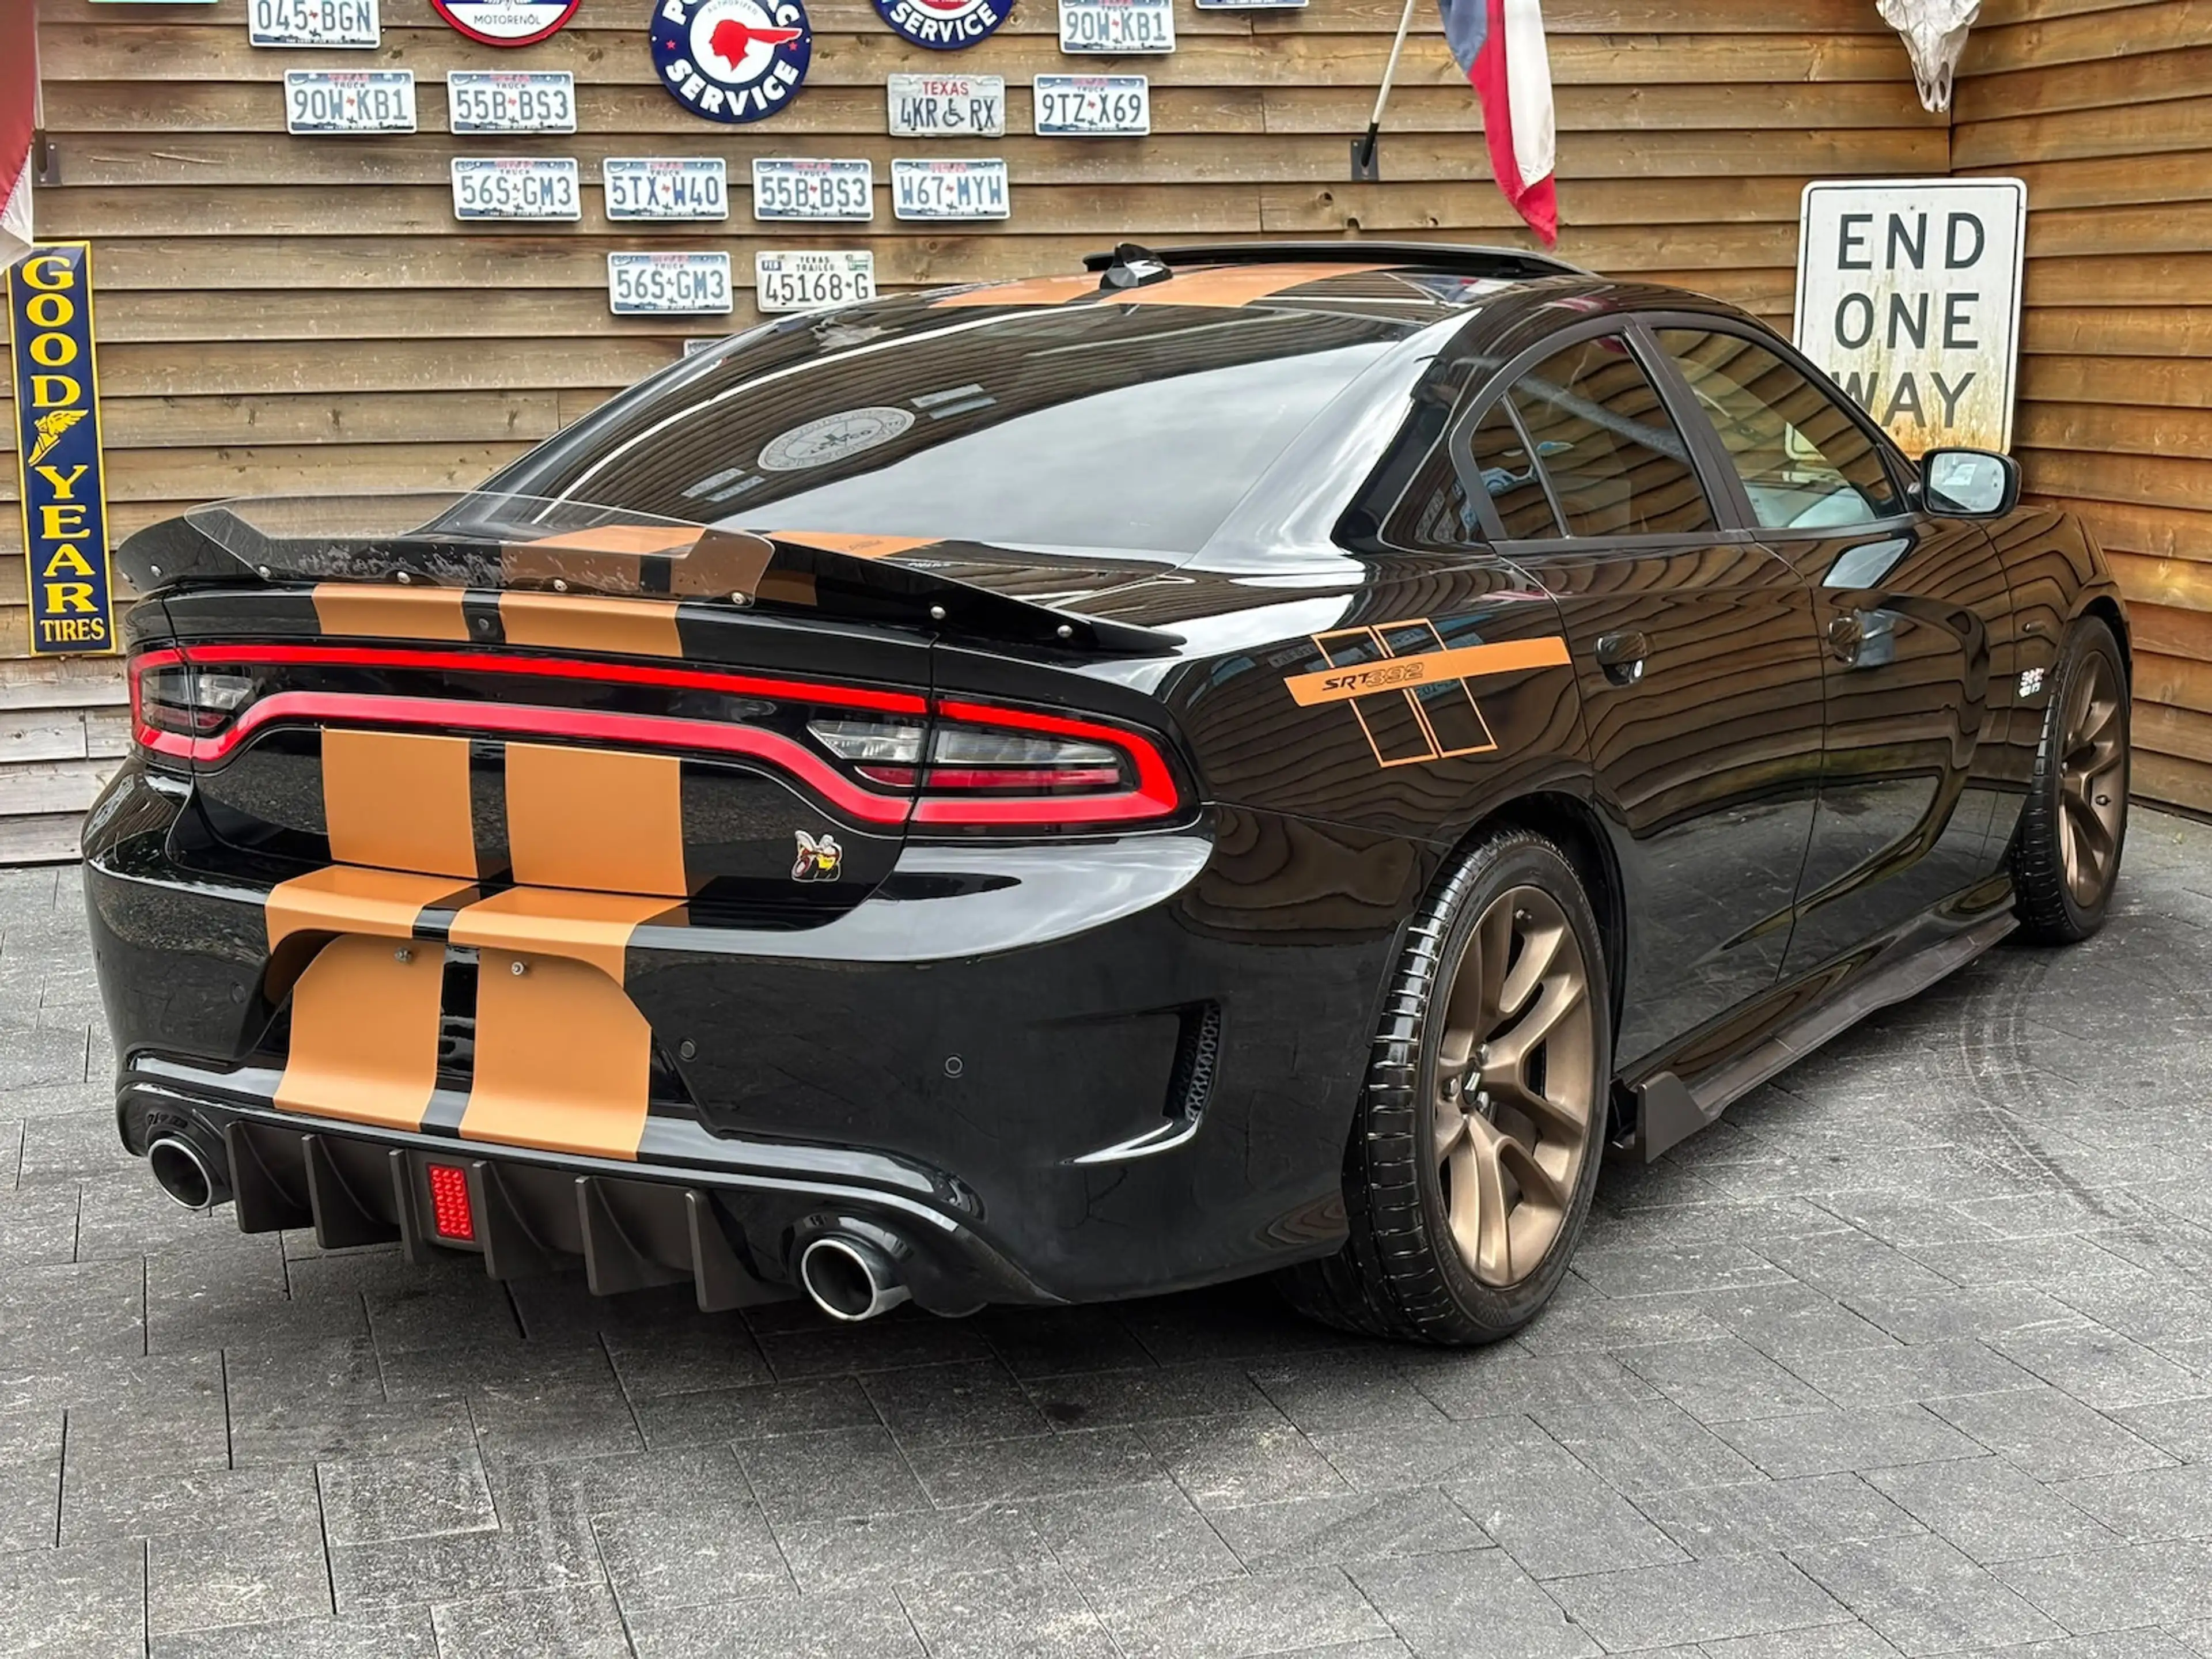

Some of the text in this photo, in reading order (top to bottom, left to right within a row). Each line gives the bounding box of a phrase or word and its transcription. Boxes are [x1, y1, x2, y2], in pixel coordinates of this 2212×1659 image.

[321, 1, 372, 32] BGN
[889, 2, 998, 43] SERVICE
[665, 59, 800, 115] SERVICE
[923, 81, 969, 96] TEXAS
[457, 90, 569, 120] 55B BS3
[1042, 94, 1142, 123] 9TZ X69
[1837, 212, 1986, 270] END
[1834, 293, 1980, 350] ONE
[40, 618, 105, 642] TIRES
